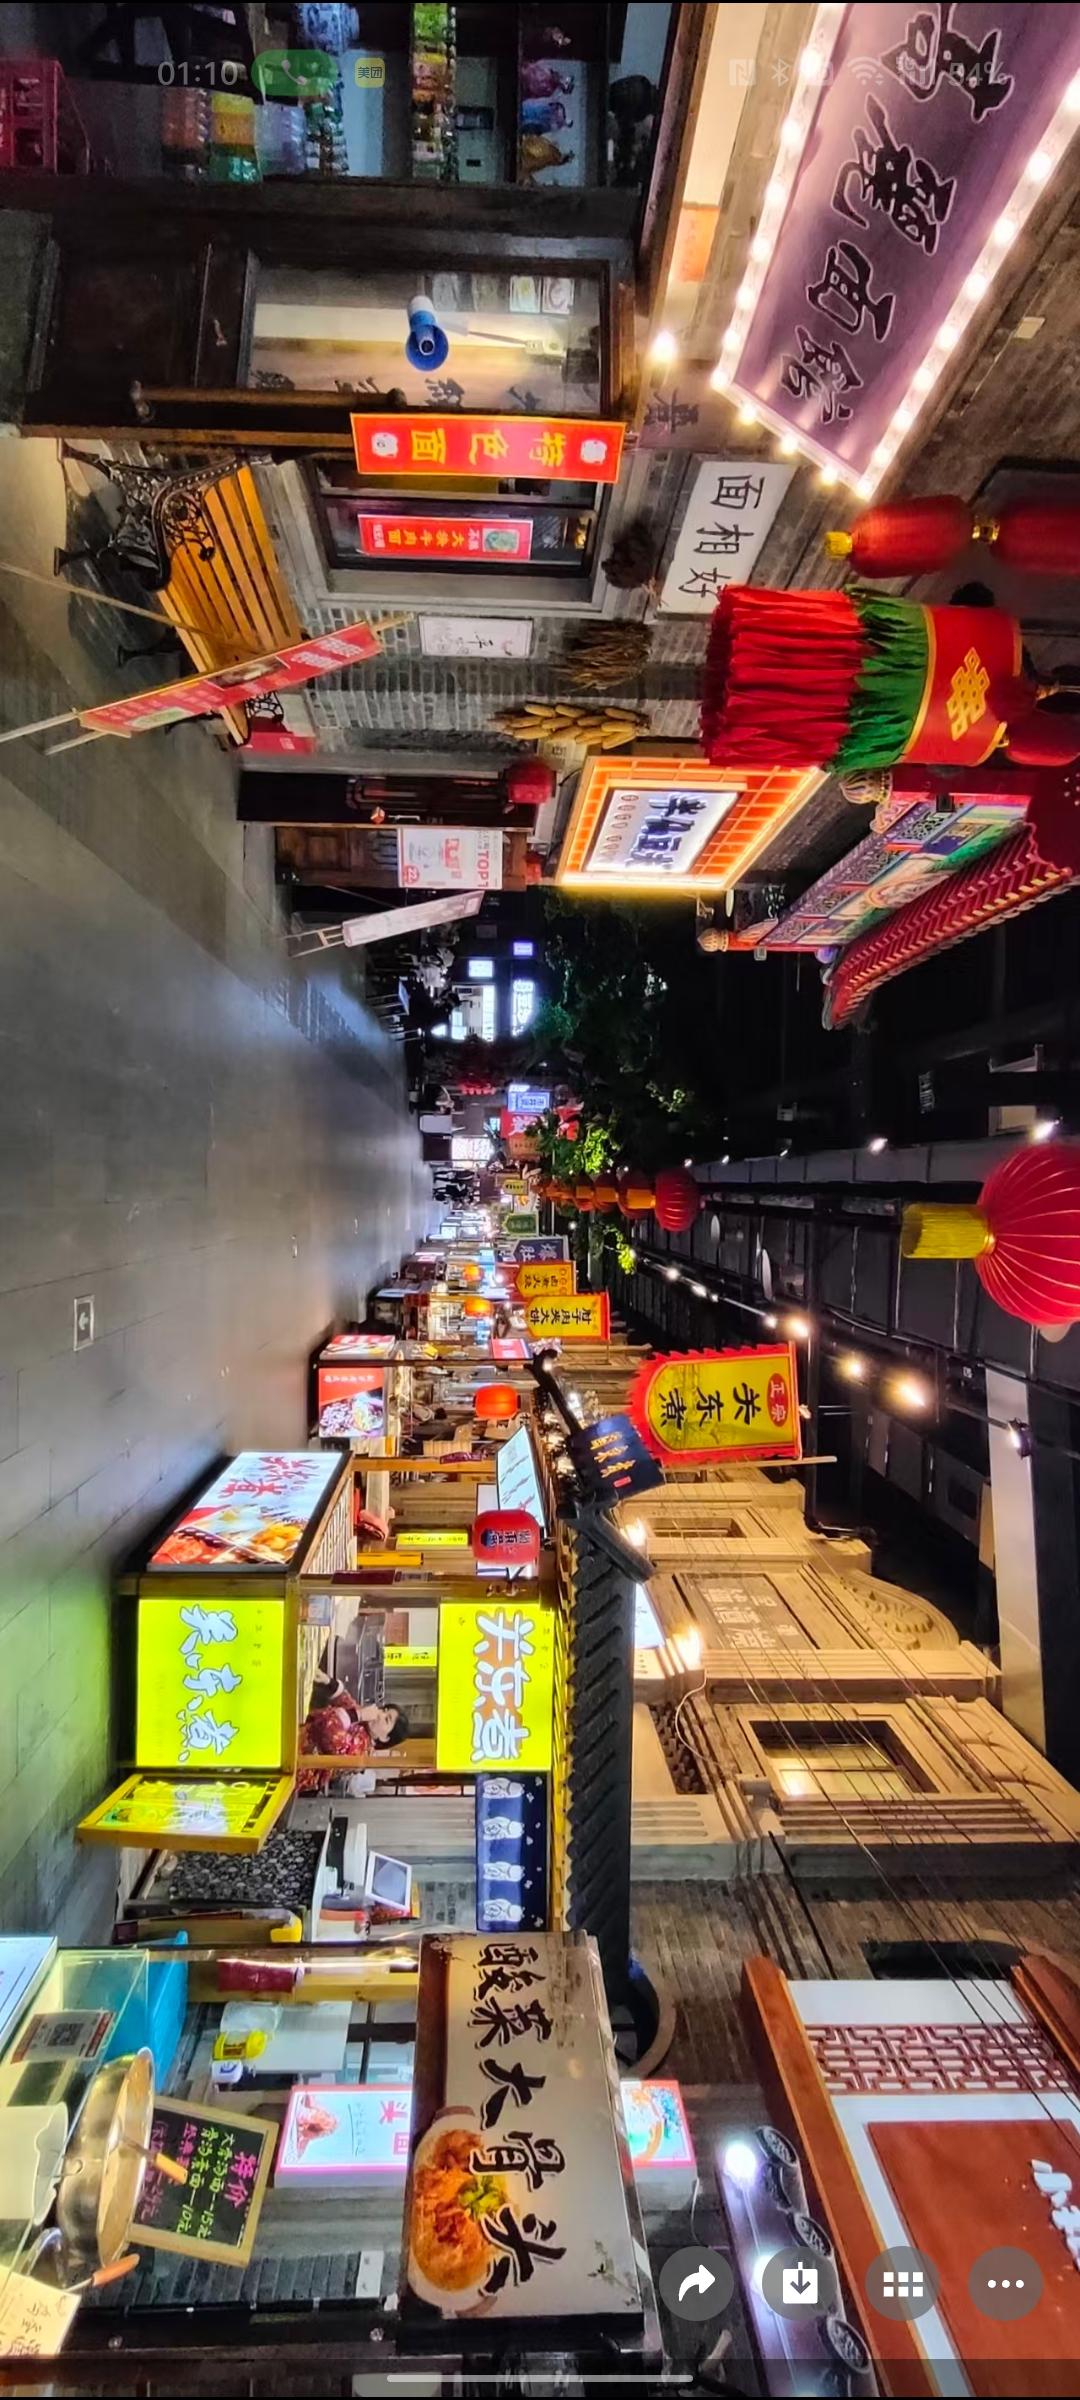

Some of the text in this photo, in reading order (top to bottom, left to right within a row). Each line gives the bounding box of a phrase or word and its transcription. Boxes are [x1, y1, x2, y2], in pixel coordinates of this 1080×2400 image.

[410, 427, 566, 469] 特色面
[678, 475, 765, 598] 面相好
[530, 1307, 592, 1325] 肘子肉夹大饼
[659, 1382, 761, 1431] 关东煮
[772, 1381, 787, 1423] 正宗
[176, 1604, 243, 1763] 关东煮
[471, 1608, 535, 1763] 关东煮
[469, 1942, 566, 2296] 酸菜大骨头
[224, 2152, 257, 2208] 特价
